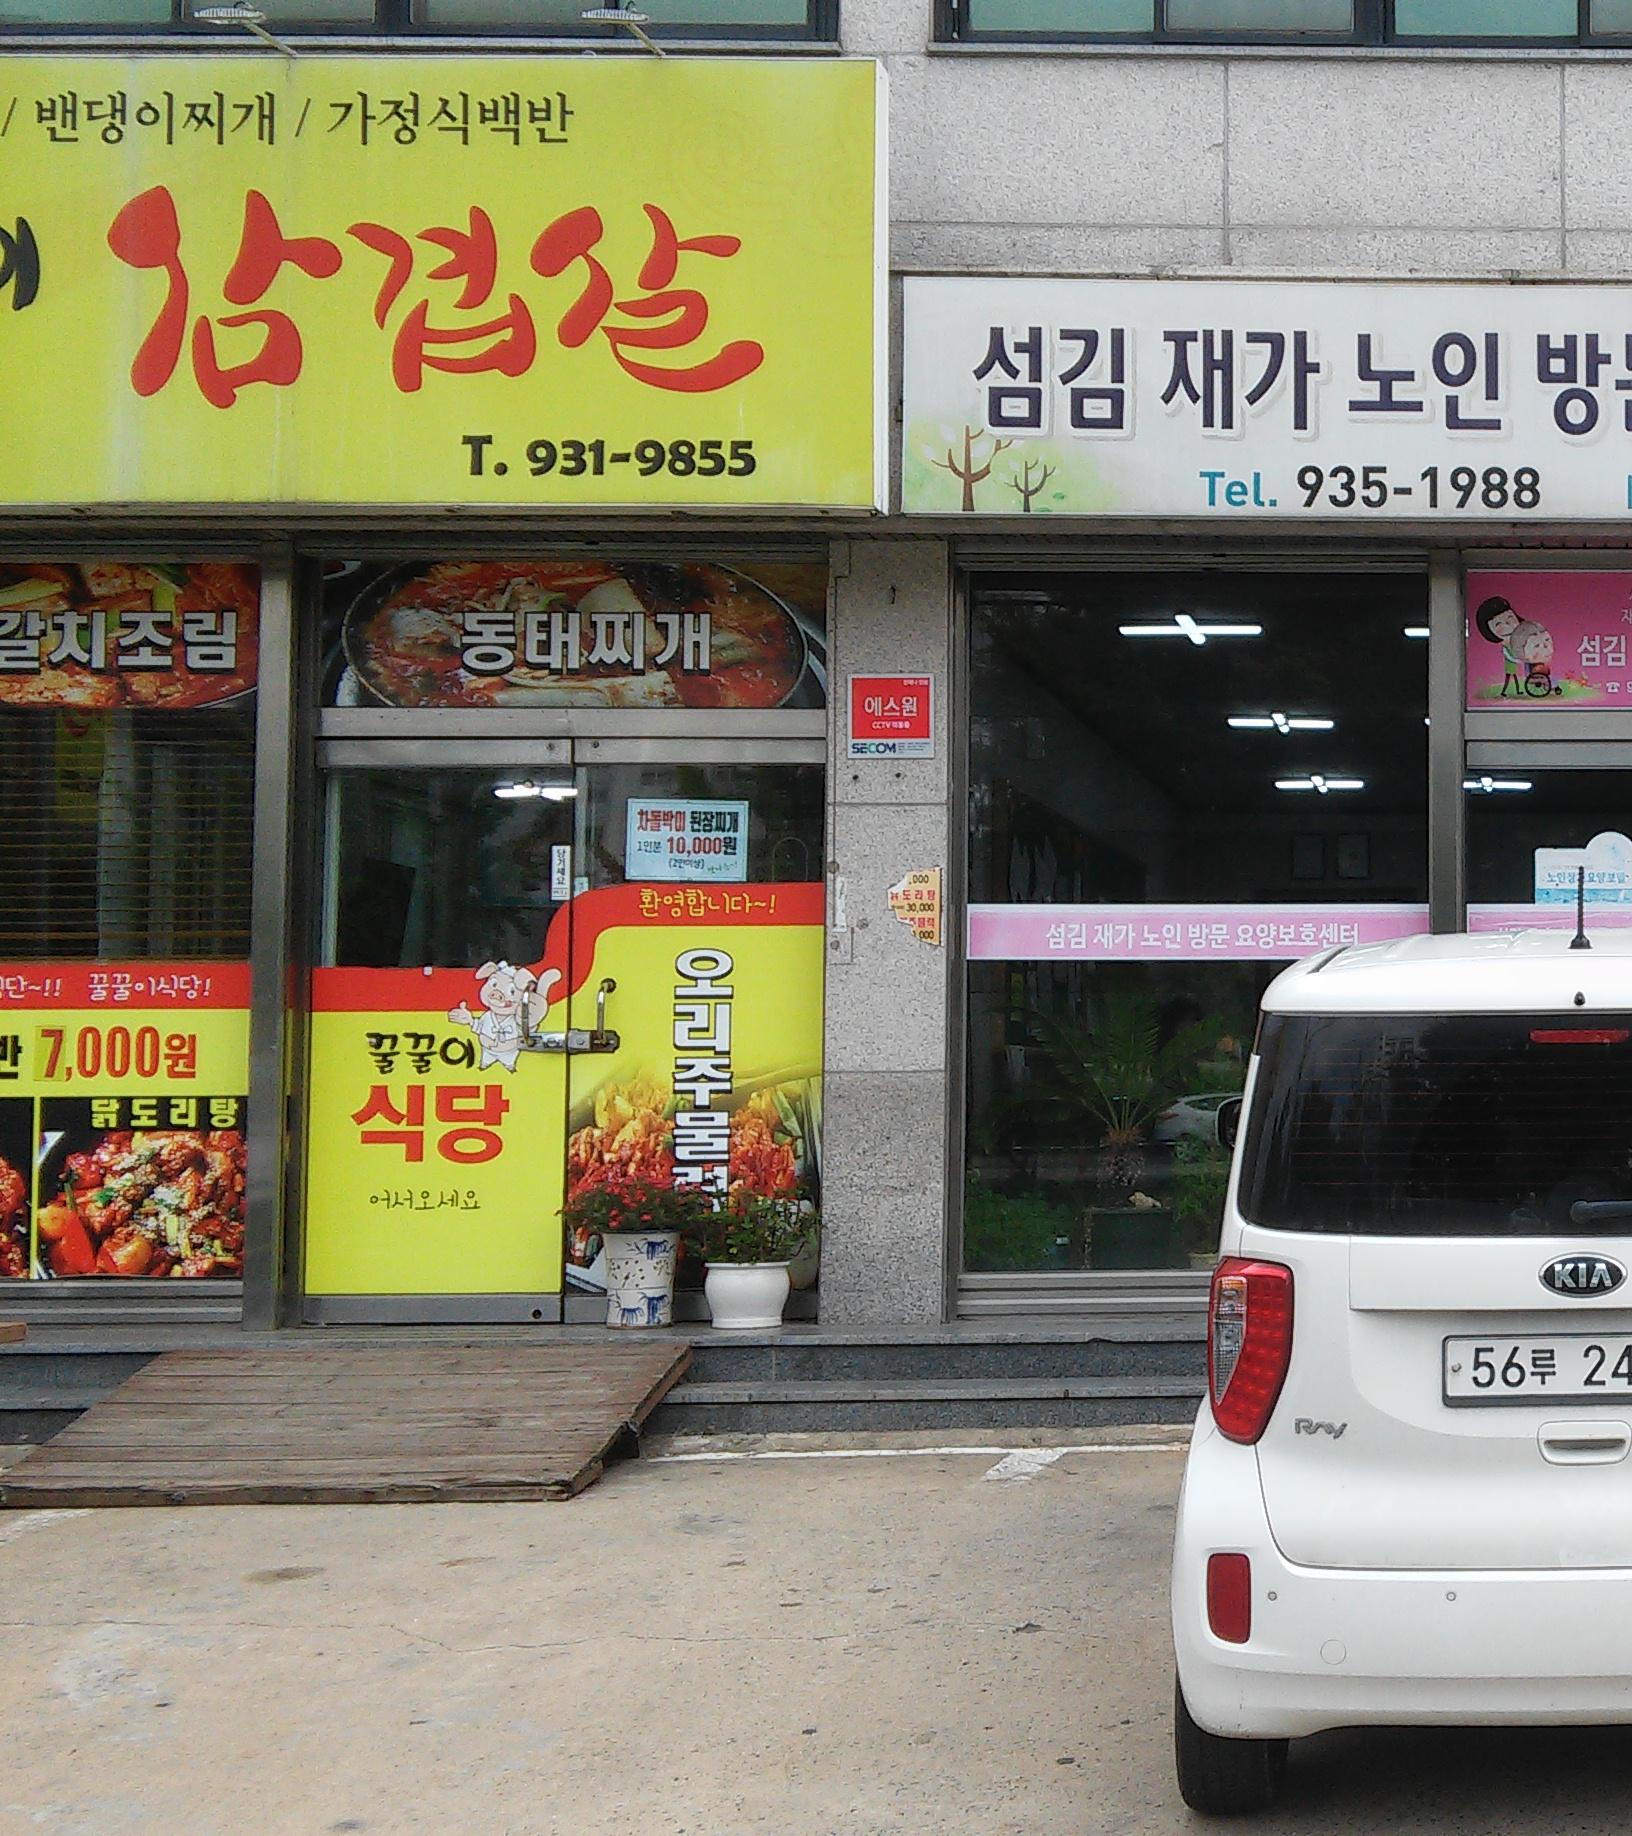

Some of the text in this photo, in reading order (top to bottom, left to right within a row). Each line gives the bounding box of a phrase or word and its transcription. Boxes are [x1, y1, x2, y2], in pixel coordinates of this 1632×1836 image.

[35, 90, 276, 147] 밴댕이찌개
[327, 90, 576, 147] 가정식백반
[107, 184, 765, 410] 삼겹살
[973, 326, 1126, 430] 섬김
[1161, 329, 1320, 430] 재가
[1348, 331, 1502, 431] 노인
[461, 434, 757, 478] T. 931-9855
[1200, 469, 1278, 507] Tel.
[1296, 464, 1541, 510] 935-1988
[0, 610, 239, 672] 갈치조림
[461, 611, 713, 675] 동태찌개
[1577, 634, 1627, 667] 섬김
[864, 696, 918, 717] 에스원
[852, 742, 897, 754] SECOM
[637, 808, 739, 833] 차돌박이 된장찌개
[667, 836, 737, 857] 10,000원
[1546, 870, 1626, 884] 노인장요양보험
[639, 888, 777, 919] 환영합니다~!
[1046, 922, 1360, 949] 섬김 재가 노인 방문 요양보호센터
[88, 973, 212, 1001] 꿀꿀이식당!
[40, 1026, 198, 1082] 7,000원
[366, 1031, 477, 1074] 꿀꿀이
[672, 947, 735, 1212] 오리주물럭
[350, 1083, 510, 1164] 식당
[369, 1188, 482, 1212] 어서오세요
[1553, 1262, 1613, 1288] KIA
[1472, 1345, 1557, 1389] 56루
